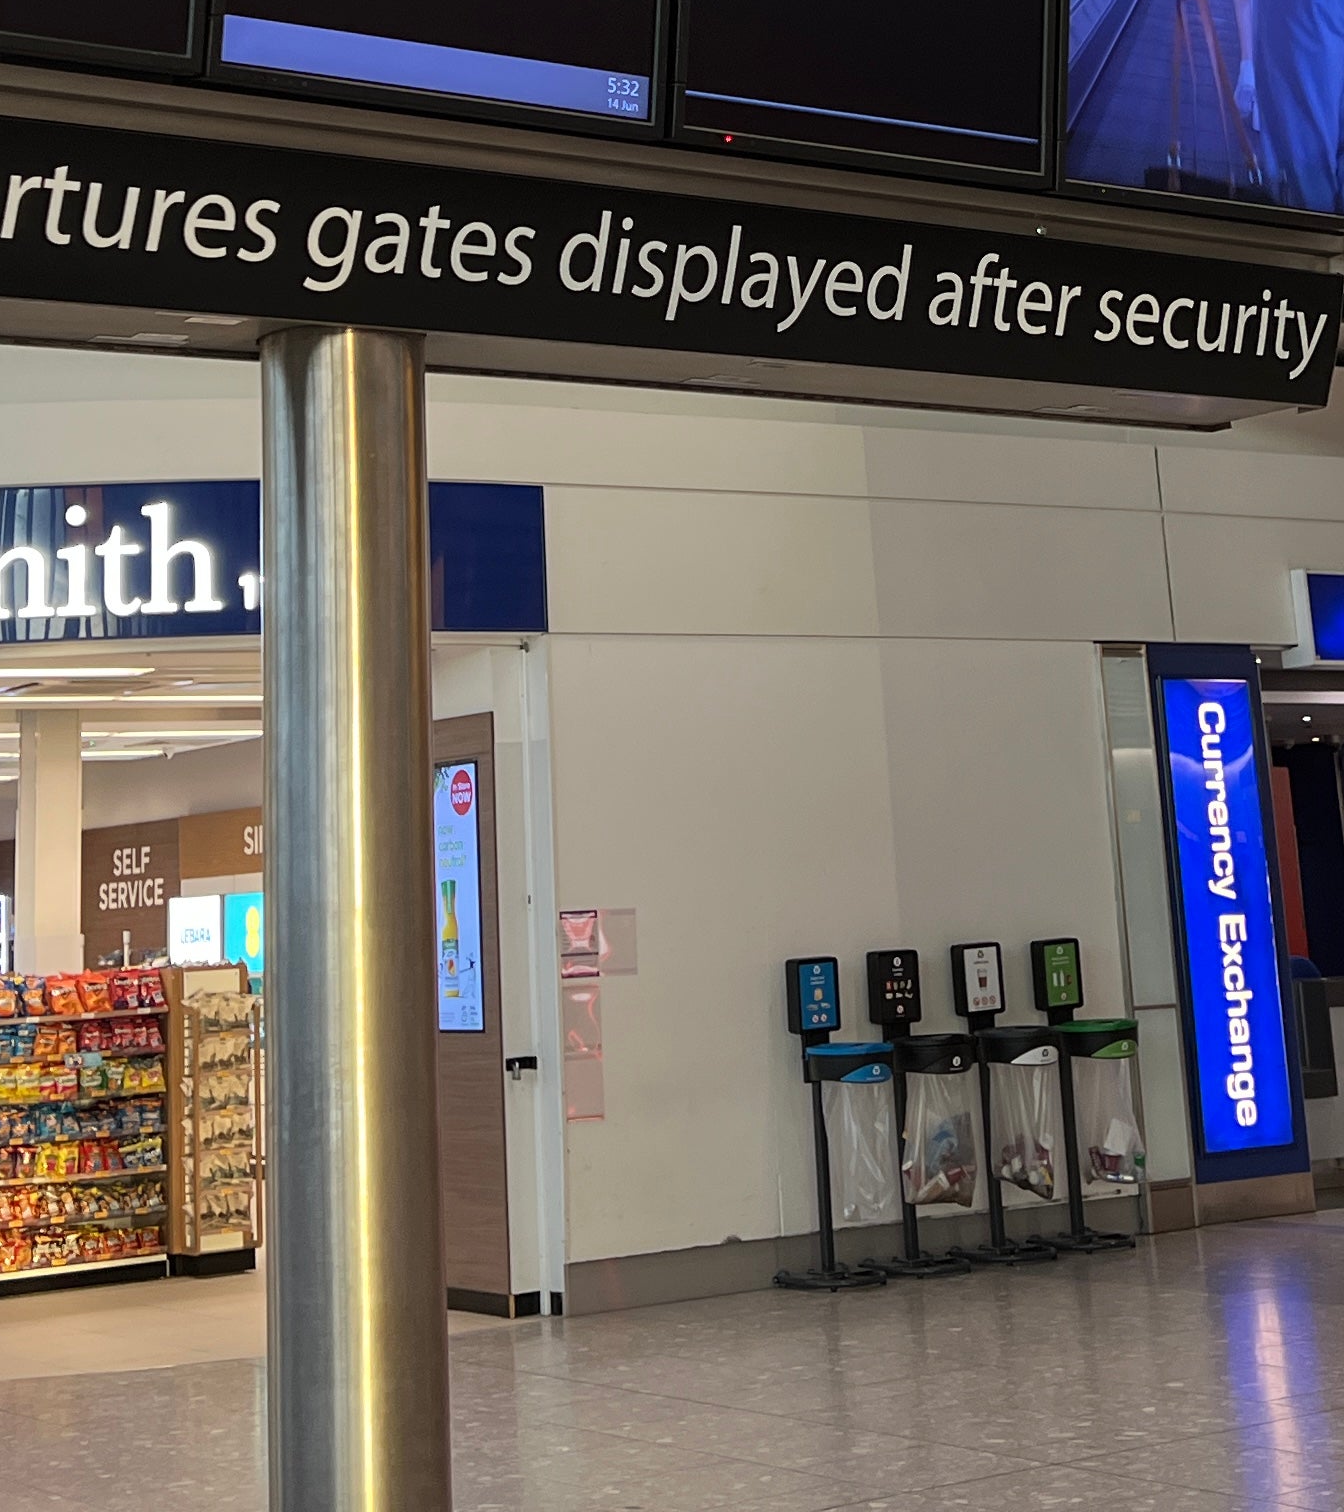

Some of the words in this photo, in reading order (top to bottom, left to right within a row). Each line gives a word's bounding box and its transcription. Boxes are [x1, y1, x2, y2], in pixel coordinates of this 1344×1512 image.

[607, 77, 640, 97] 5:32
[303, 203, 536, 293] gates
[559, 209, 914, 333] displayed
[927, 252, 1082, 340] after
[1093, 288, 1328, 381] security
[113, 845, 151, 877] SELF
[99, 877, 164, 911] SERVICE
[1197, 701, 1237, 901] Currency
[1217, 912, 1259, 1128] Exchange
